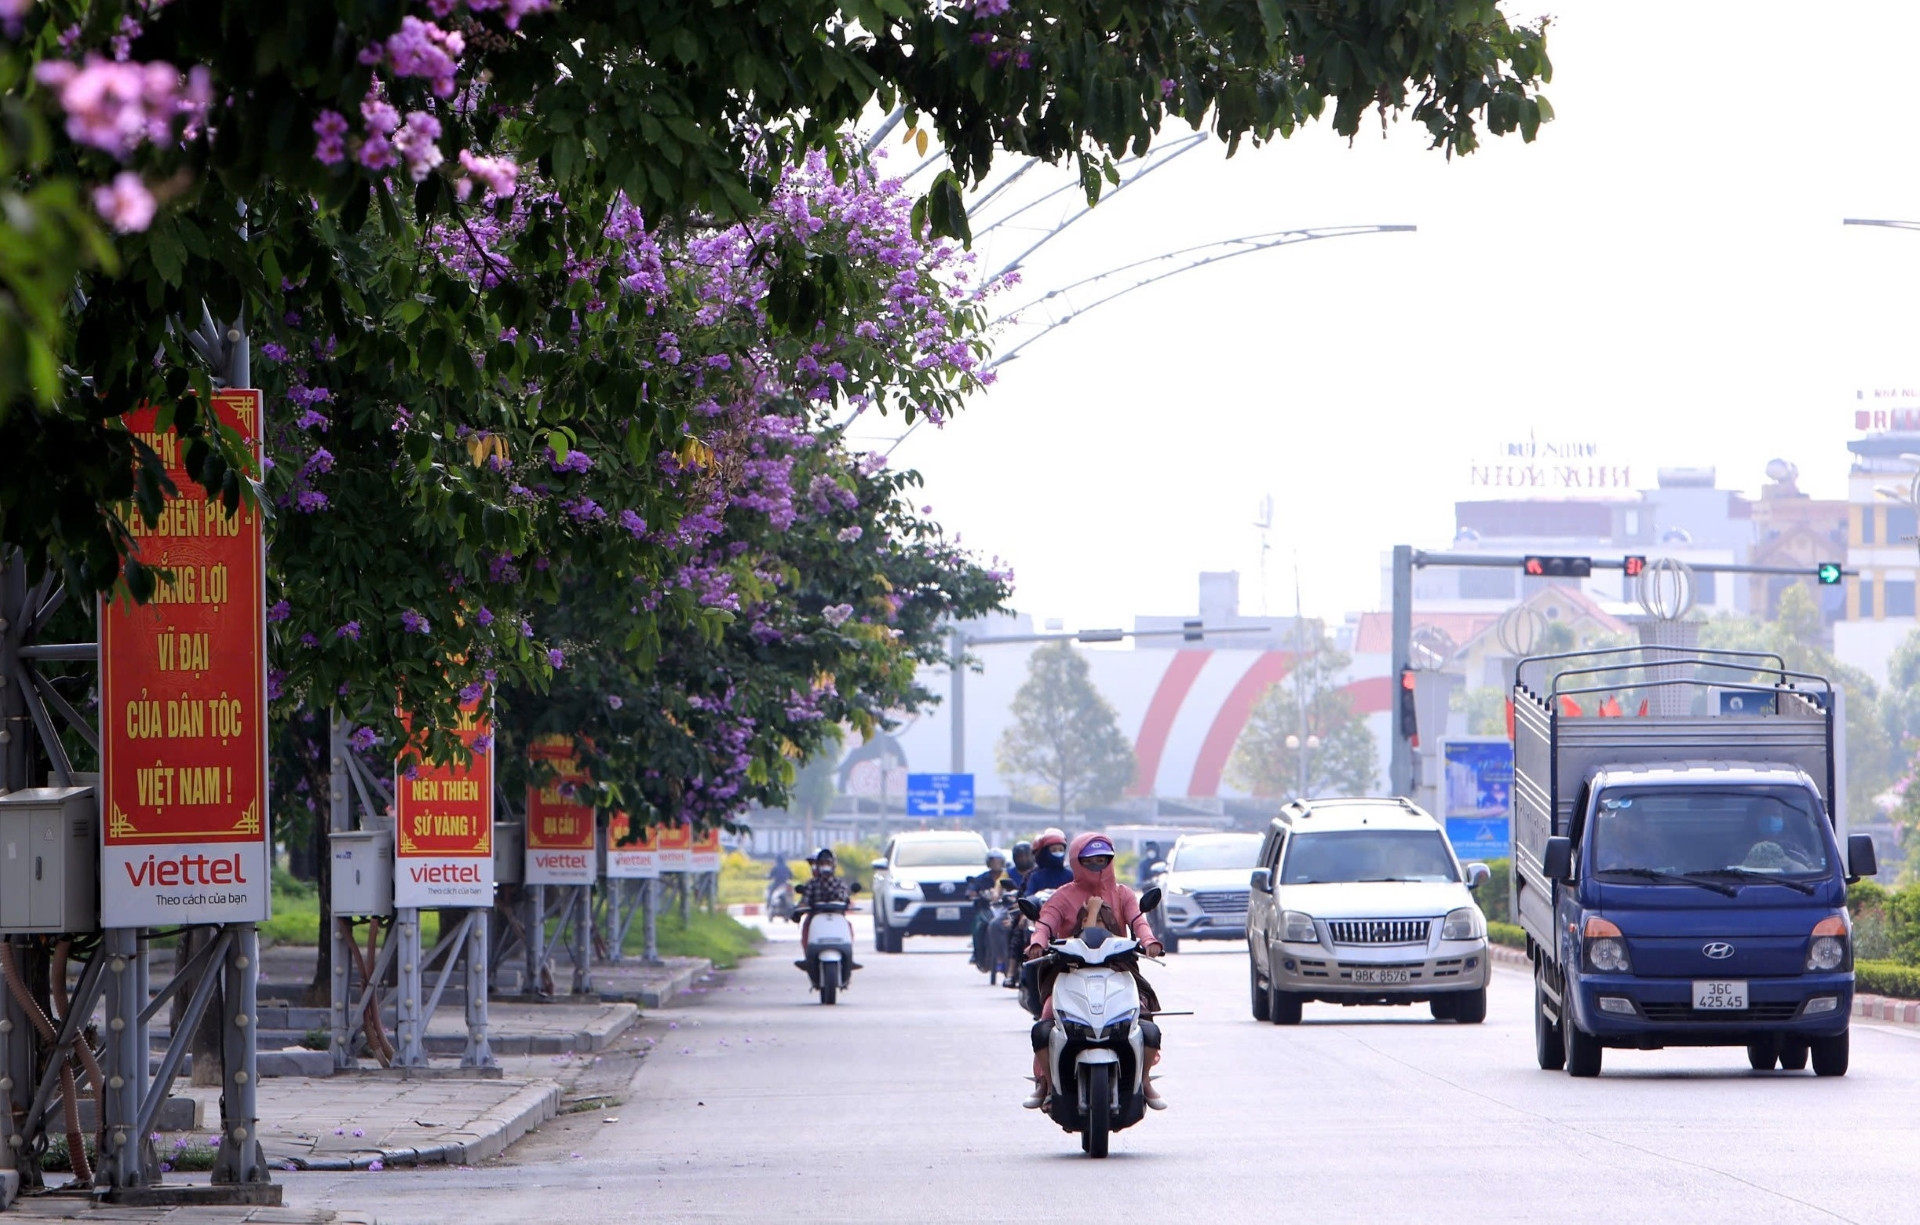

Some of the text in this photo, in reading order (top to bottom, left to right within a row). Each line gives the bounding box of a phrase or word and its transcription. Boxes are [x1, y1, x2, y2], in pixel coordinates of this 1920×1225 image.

[159, 491, 199, 537] BIÊN
[148, 551, 228, 612] ẮNG LỢI
[157, 626, 209, 679] VĨ ĐẠI
[126, 688, 242, 746] CỦA DÂN TỘC
[137, 760, 174, 814] VIỆT
[180, 767, 220, 806] NAM
[442, 776, 479, 801] THIÊN
[414, 809, 432, 837] SỬ
[434, 811, 469, 837] VÀNG
[124, 853, 247, 887] viettel
[410, 863, 482, 883] viettel
[535, 853, 587, 868] viettel
[156, 892, 247, 906] Theo cách của bạn
[1699, 996, 1743, 1008] 425.45
[1708, 983, 1732, 995] 36C
